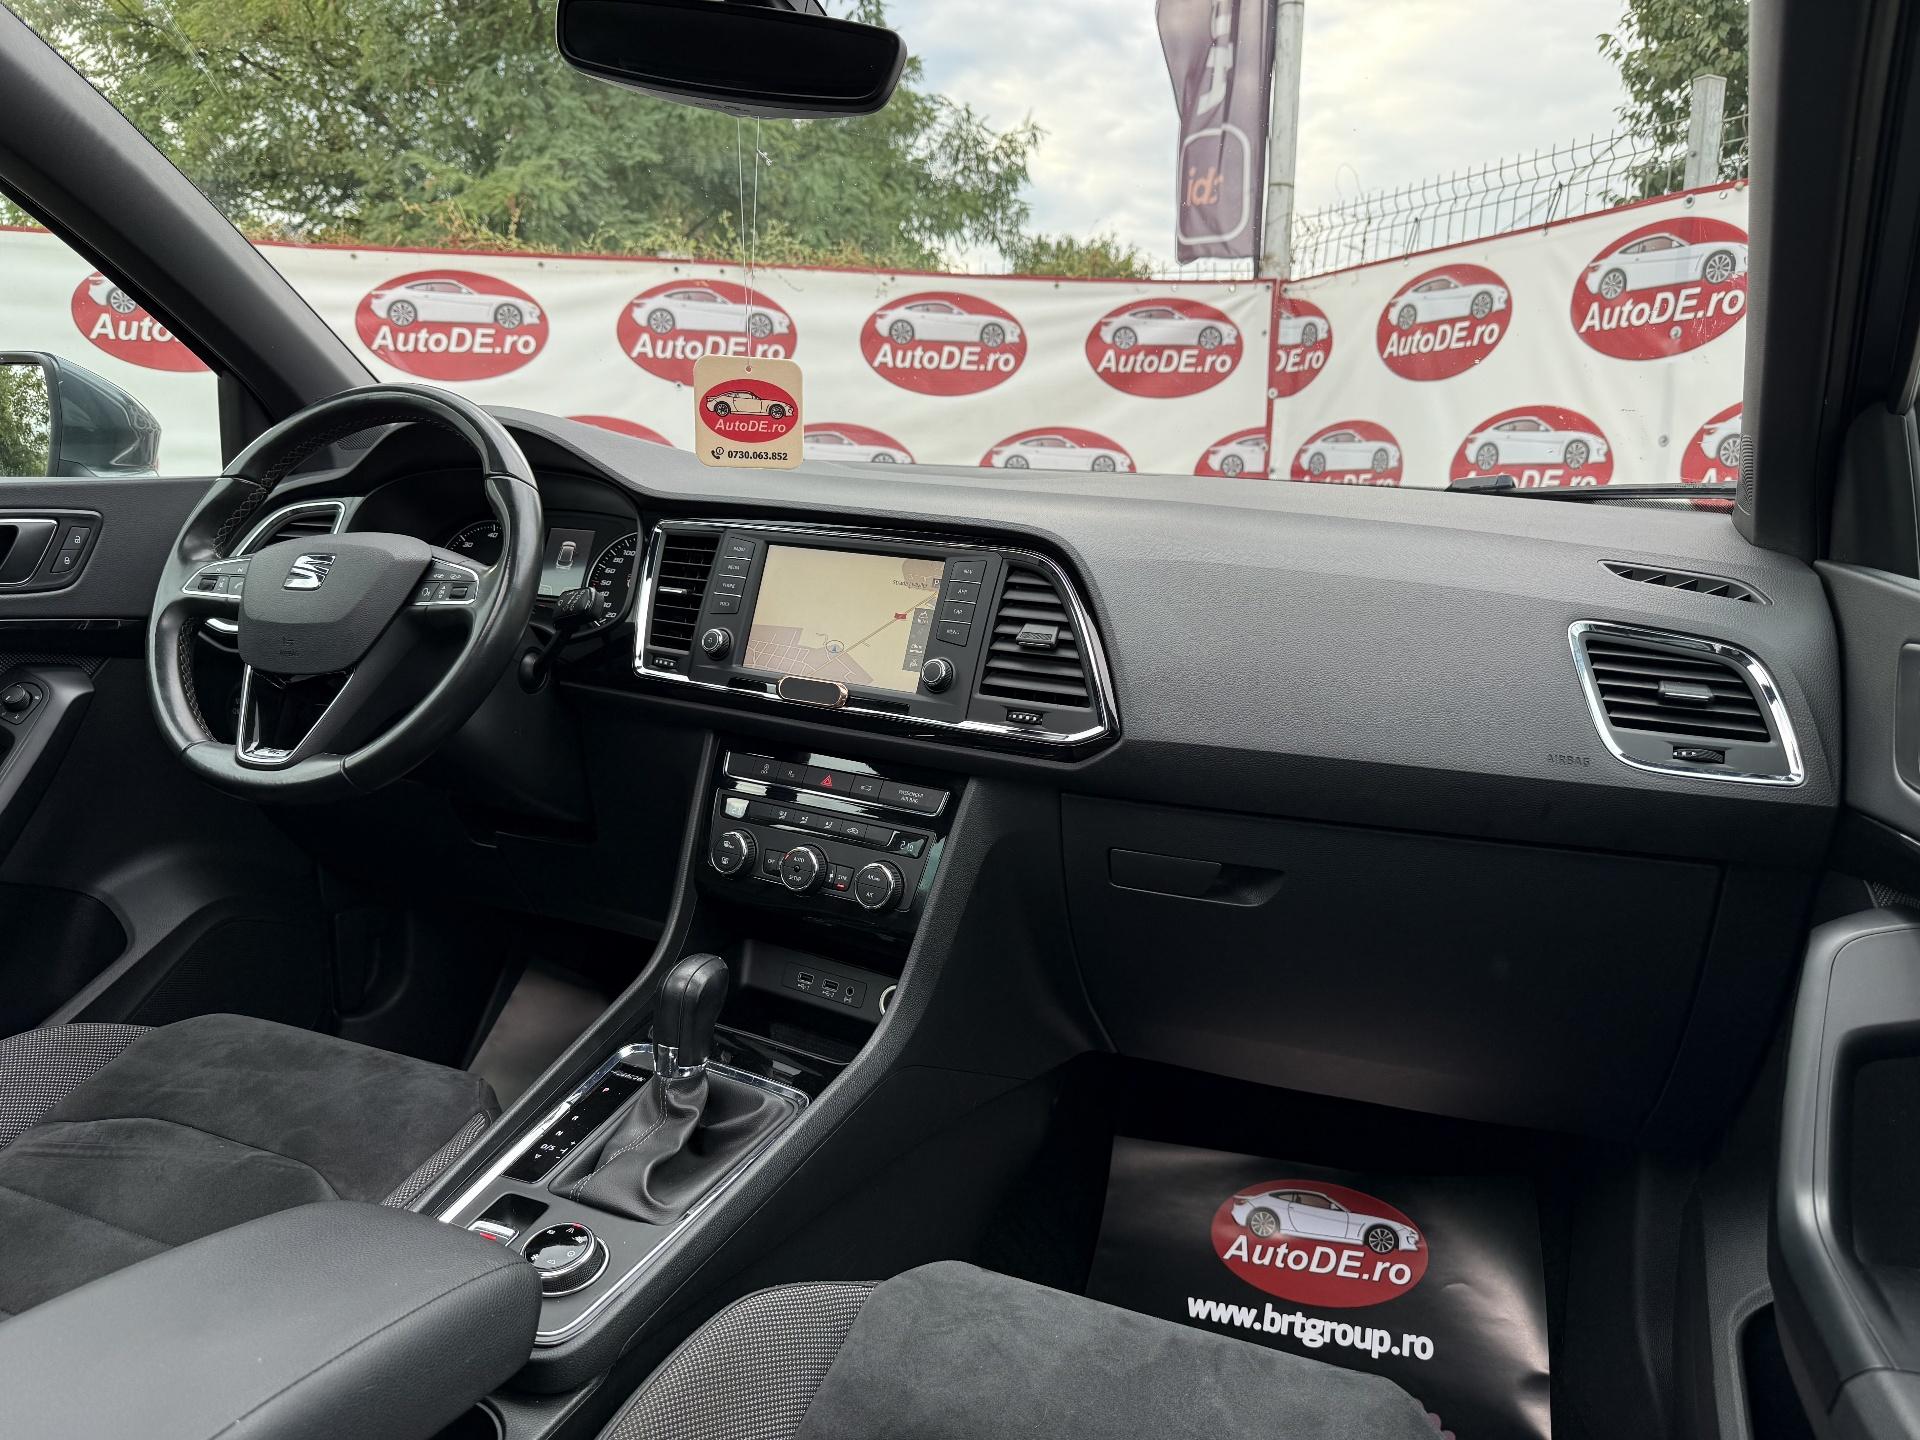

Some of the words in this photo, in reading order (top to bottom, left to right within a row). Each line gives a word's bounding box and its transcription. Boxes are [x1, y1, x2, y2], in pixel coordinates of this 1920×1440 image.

[1578, 286, 1745, 334] AutoDE.ro
[371, 324, 537, 355] AutoDE.ro
[630, 332, 786, 359] AutoDEro
[1382, 320, 1500, 359] AutoDE.ro
[872, 342, 1016, 373] AutoDE.ro
[1097, 348, 1233, 374] AutoDE.ro
[714, 418, 786, 434] AutoDE.ro
[727, 450, 788, 461] 0730.063.852
[1223, 1234, 1412, 1285] AutoDE.ro
[1186, 1296, 1434, 1361] www.brtgroup.ro
